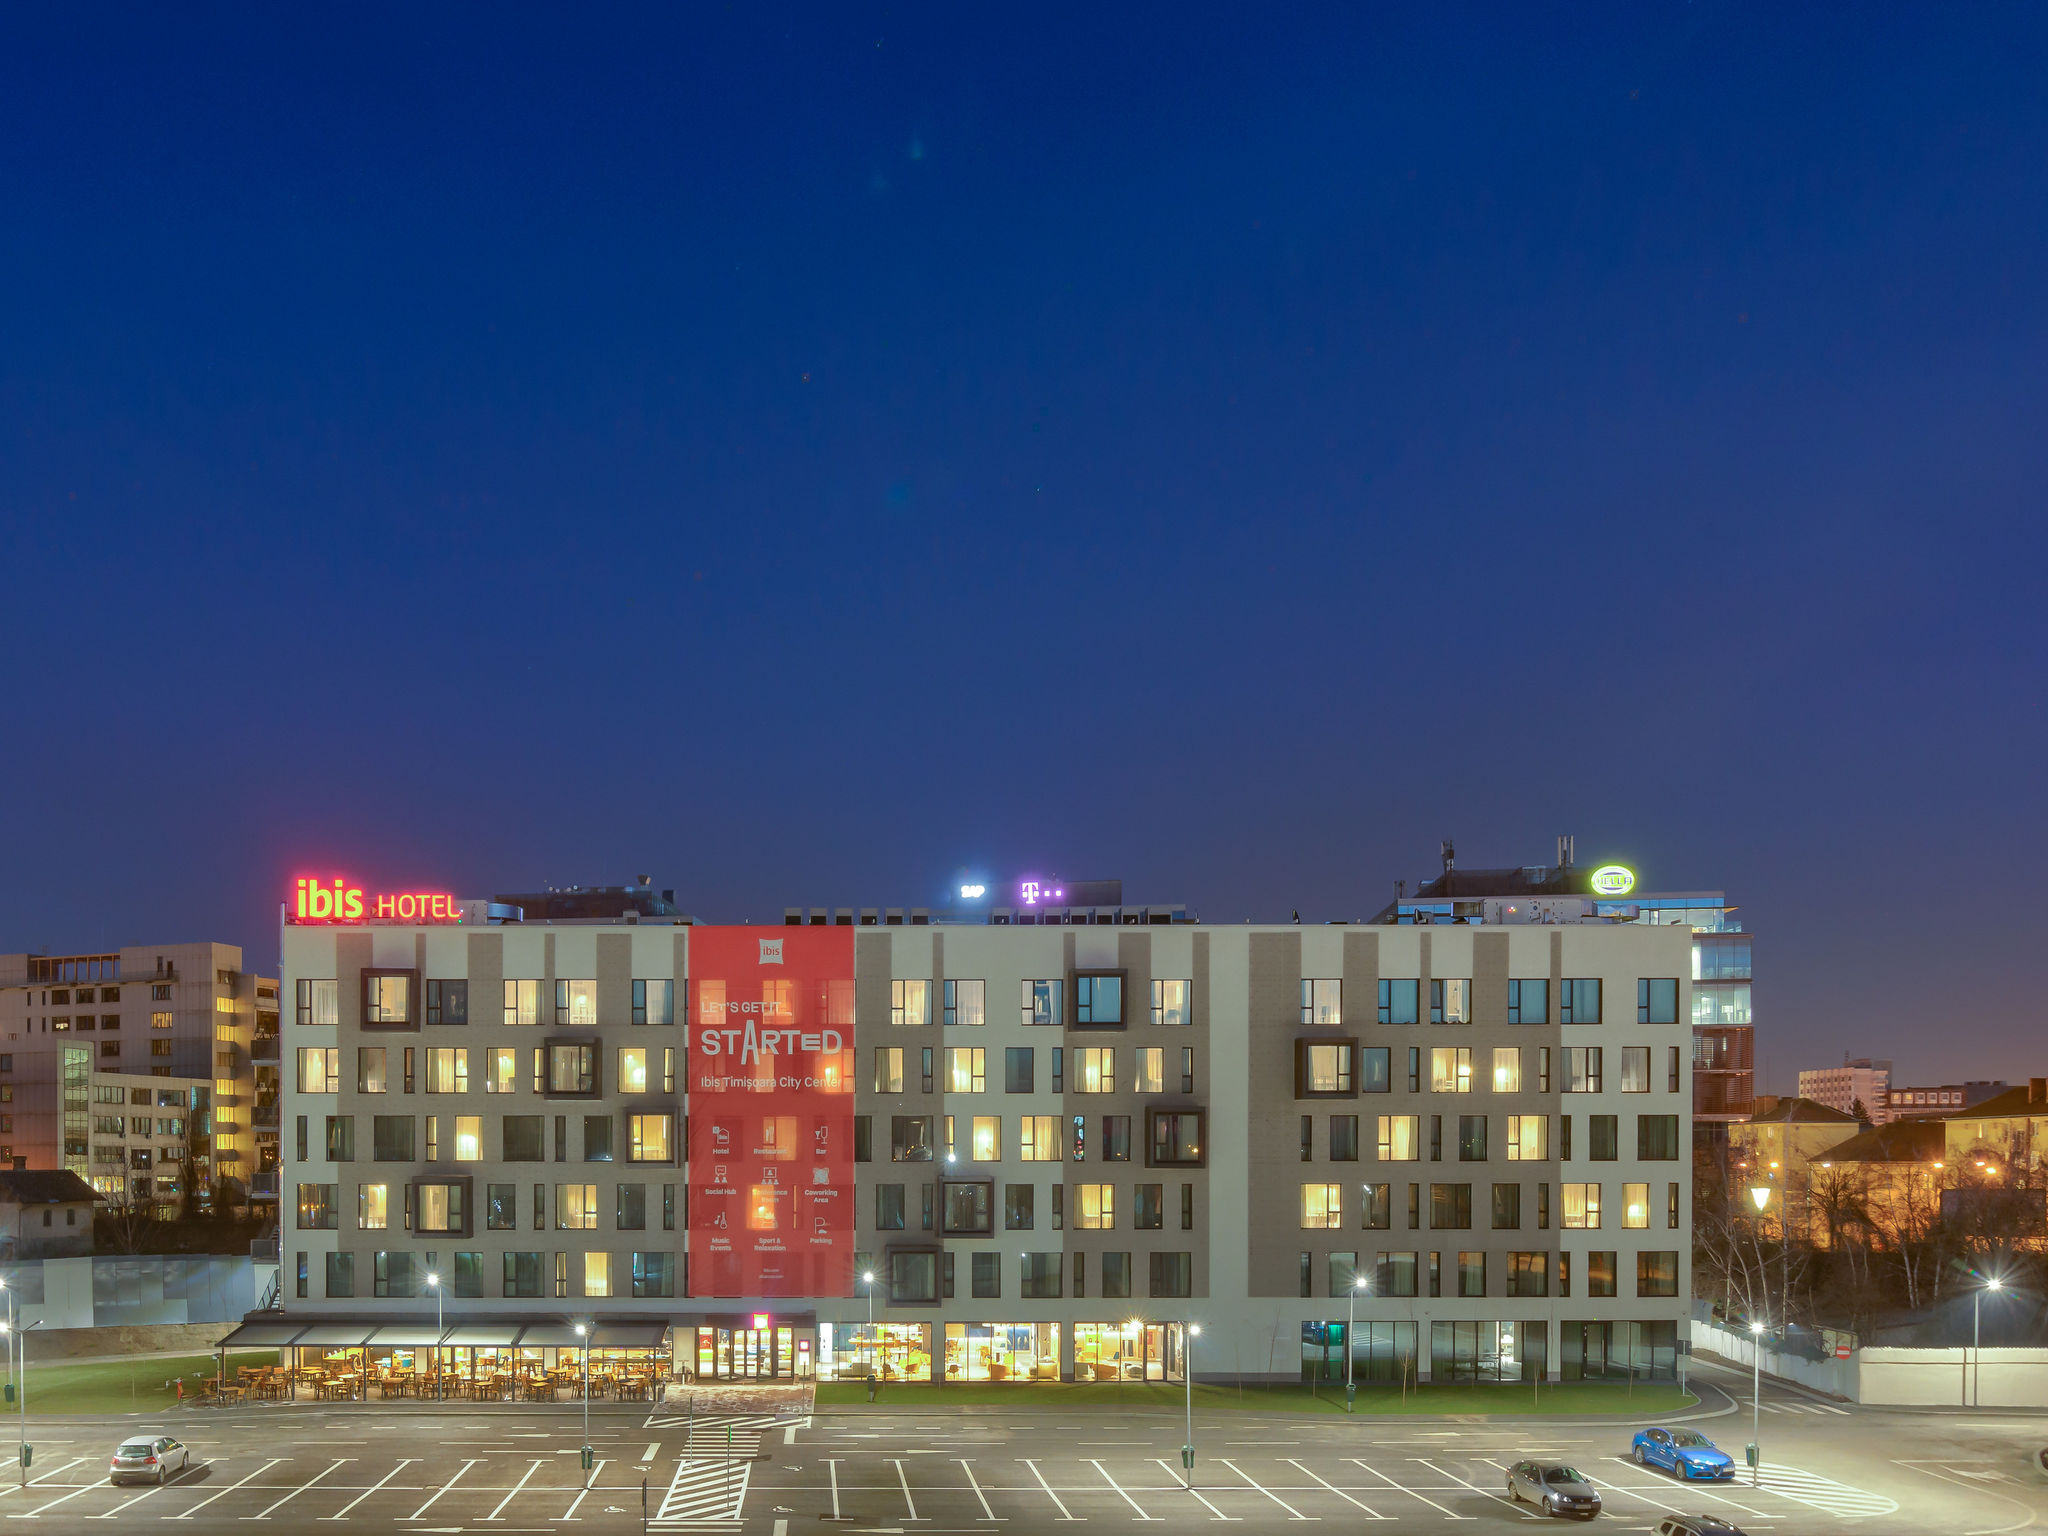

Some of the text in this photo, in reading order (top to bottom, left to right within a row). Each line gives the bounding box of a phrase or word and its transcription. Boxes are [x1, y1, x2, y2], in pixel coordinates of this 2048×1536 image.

[298, 879, 460, 918] ibis HOTEL
[763, 946, 780, 956] ibis
[741, 1002, 766, 1013] GET
[701, 1020, 842, 1065] STARTED
[701, 1076, 720, 1088] Ibis
[779, 1076, 801, 1090] City
[804, 1076, 842, 1088] Center
[804, 1189, 838, 1197] Coworking
[758, 1237, 776, 1246] Sport
[809, 1237, 833, 1245] Parking
